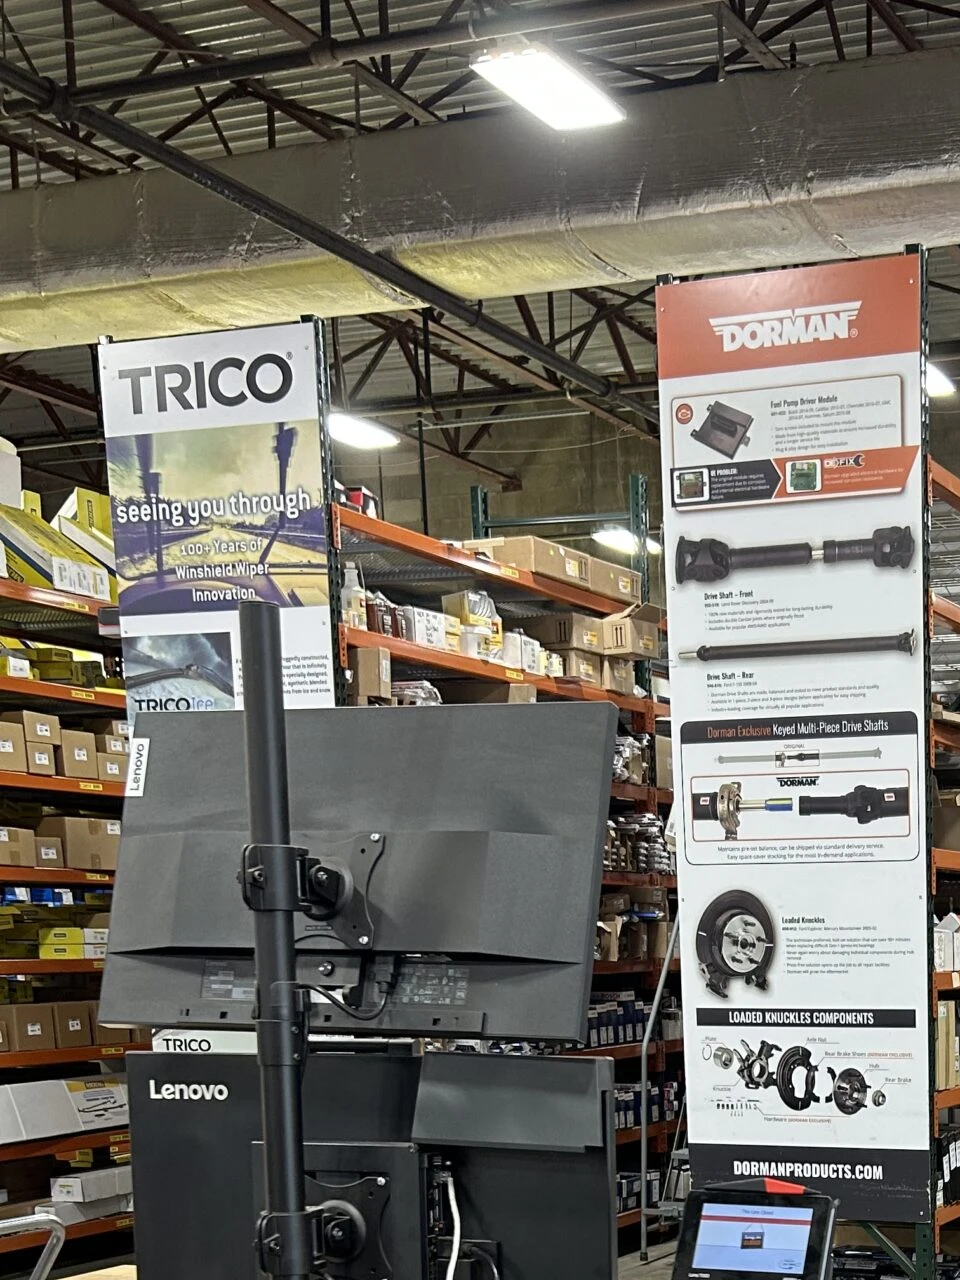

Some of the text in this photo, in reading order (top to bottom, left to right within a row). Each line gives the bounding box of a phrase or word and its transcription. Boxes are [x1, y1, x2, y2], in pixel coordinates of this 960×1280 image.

[714, 306, 856, 353] DORMAN
[117, 353, 293, 414] TRICO
[771, 395, 838, 409] Fuel Pump Driver Module
[116, 487, 311, 526] seeing you through
[180, 537, 263, 557] 100+ Years of
[175, 561, 269, 580] Winshield Wiper
[191, 585, 256, 603] Innovation
[704, 590, 753, 600] Drive Shaft Front
[706, 673, 720, 682] Drive
[741, 672, 755, 680] Rear
[134, 697, 191, 711] TRICO
[707, 720, 889, 738] Dorman Exclusive Keyed Multi-Piece Drive Shafts
[131, 743, 145, 793] Lenovo
[777, 776, 819, 788] DORMAN
[781, 916, 825, 924] Loaded Knuckles
[729, 1011, 874, 1025] LOADED KNUCKLES COMPONENTS
[163, 1039, 212, 1052] TRICO
[150, 1079, 229, 1102] Lenovo
[733, 1161, 883, 1180] DORMANPRODUCTS.COM
